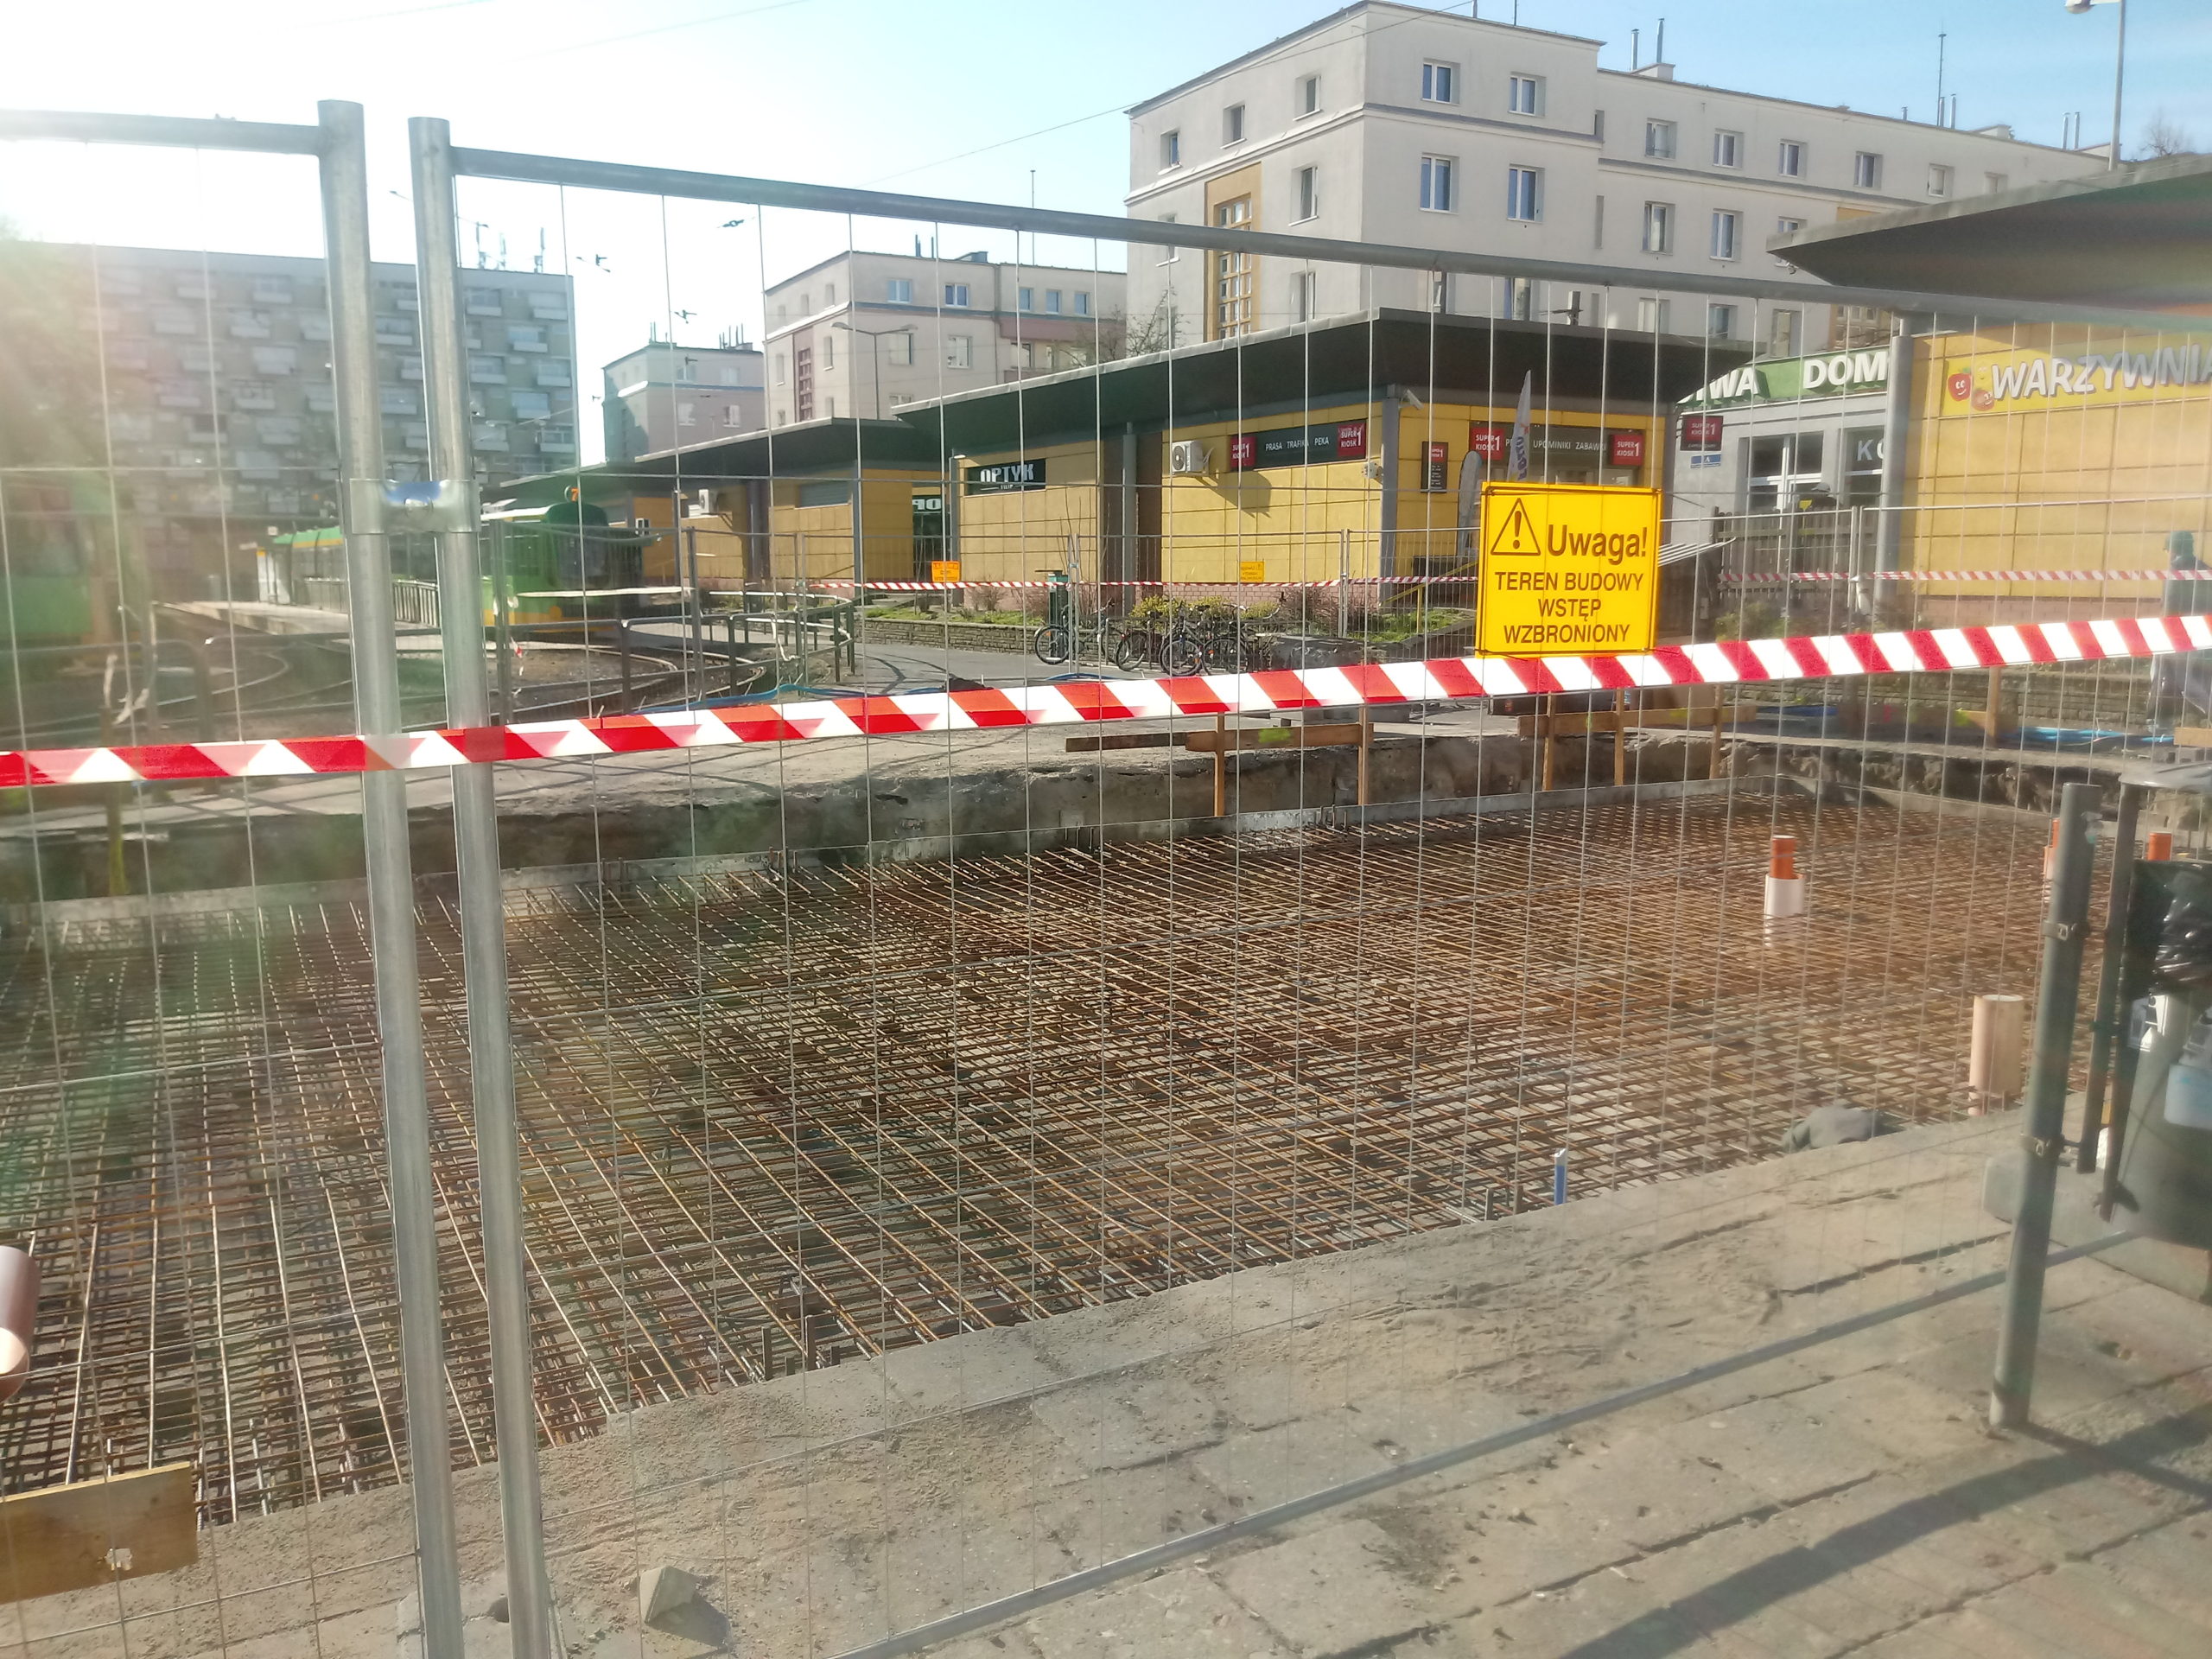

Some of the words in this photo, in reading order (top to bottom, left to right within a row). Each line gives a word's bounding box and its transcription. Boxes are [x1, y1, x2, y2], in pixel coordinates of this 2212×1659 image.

[1265, 442, 1282, 451] PRASA
[1314, 436, 1329, 446] PEKA
[980, 464, 1034, 482] OPTYK
[1548, 524, 1647, 565] Uwaga!
[1495, 572, 1558, 591] TEREN
[1564, 572, 1643, 592] BUDOWY
[1538, 599, 1601, 621] WSTĘP
[1503, 624, 1630, 644] WZBRONIONY
